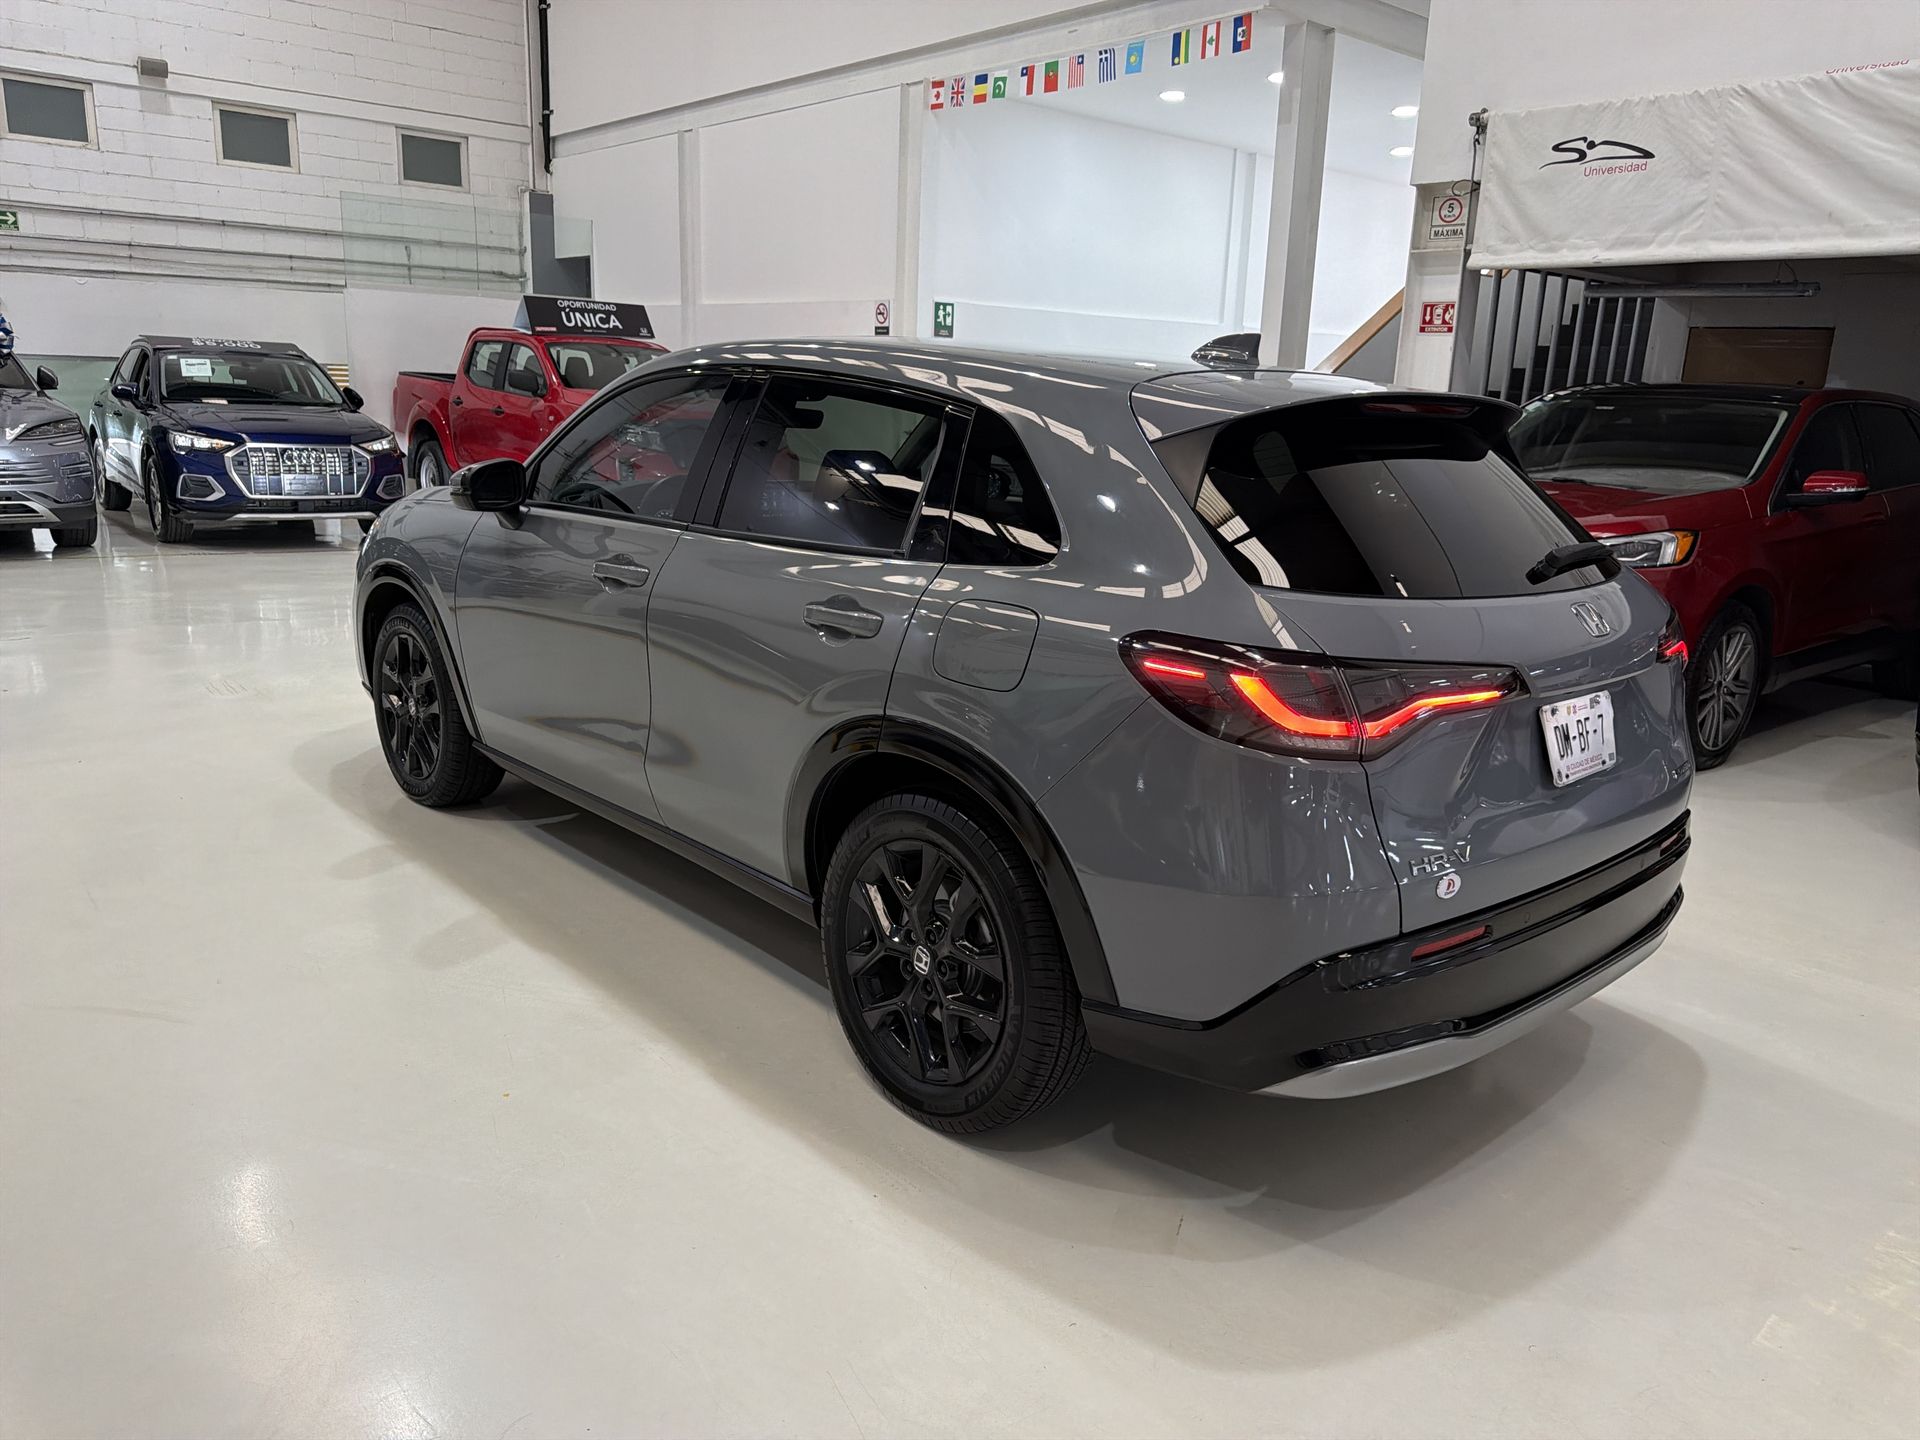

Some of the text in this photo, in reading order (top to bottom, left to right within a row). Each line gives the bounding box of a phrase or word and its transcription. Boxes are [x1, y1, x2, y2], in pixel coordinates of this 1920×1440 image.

[1583, 161, 1648, 177] Universidad
[1447, 202, 1455, 213] 5
[1433, 227, 1464, 238] MÁXIMA
[557, 300, 617, 312] OPORTUNIDAD
[560, 308, 623, 330] ÚNICA
[1409, 845, 1471, 876] HR-V
